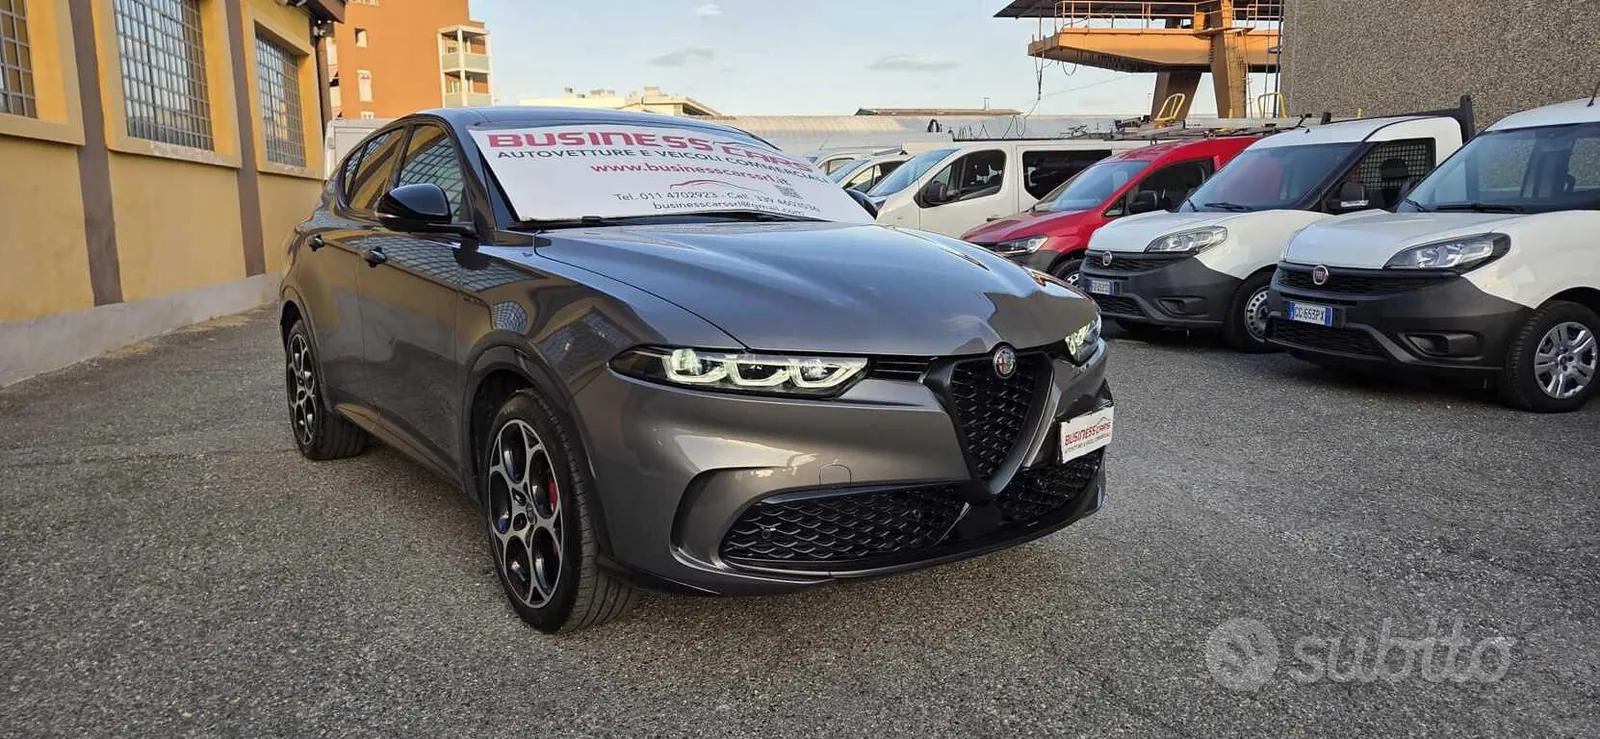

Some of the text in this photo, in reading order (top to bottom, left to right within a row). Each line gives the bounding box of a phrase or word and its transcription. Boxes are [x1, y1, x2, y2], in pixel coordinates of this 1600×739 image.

[487, 132, 813, 172] BUSINESS CARS
[498, 149, 636, 159] AUTOVETTURE
[640, 149, 652, 157] E
[655, 150, 722, 162] VEICOLI
